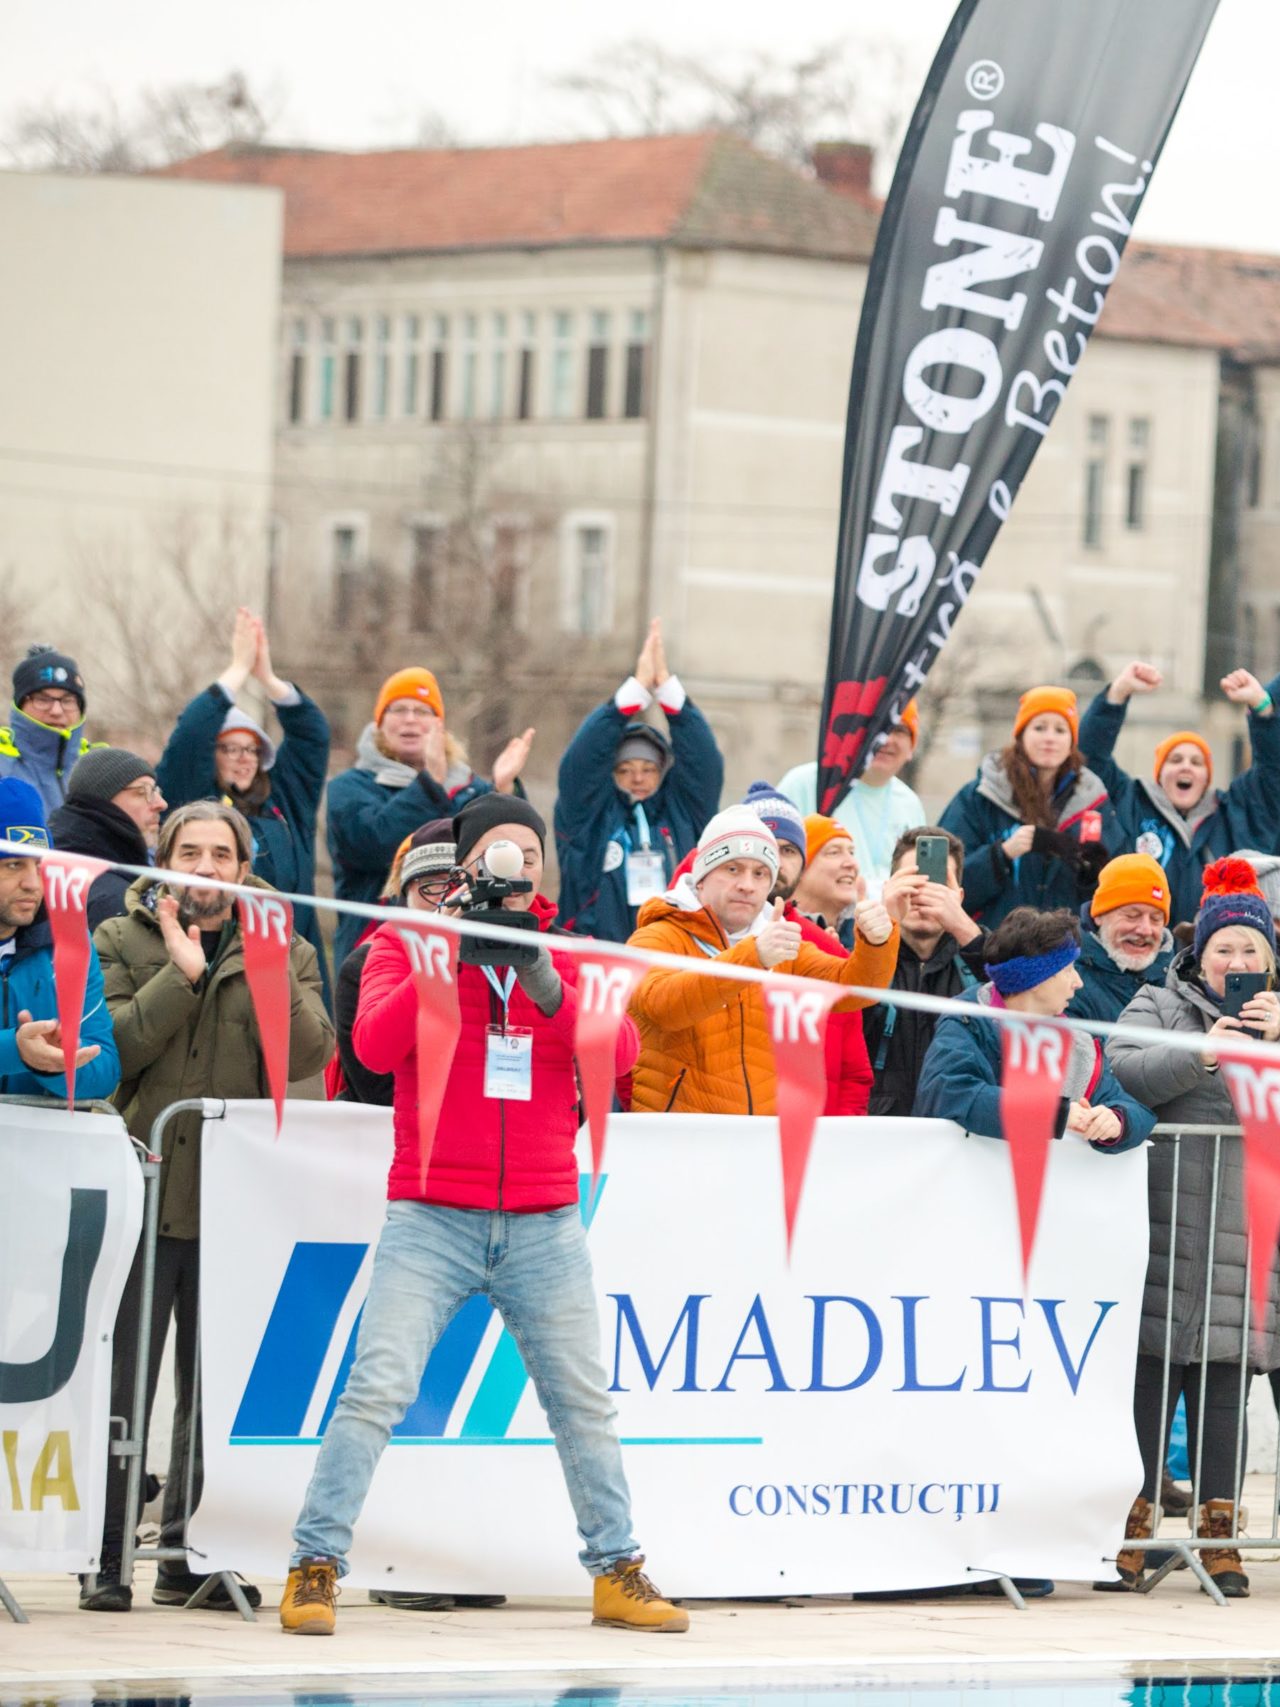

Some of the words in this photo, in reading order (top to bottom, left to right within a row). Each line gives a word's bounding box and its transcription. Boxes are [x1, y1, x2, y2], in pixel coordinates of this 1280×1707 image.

[1005, 136, 1153, 437] Beton!
[45, 866, 88, 912] TYR
[241, 893, 287, 945] TYR
[400, 929, 452, 984] TYR
[579, 962, 633, 1015] TYR
[768, 991, 824, 1043] TYR
[1004, 1020, 1063, 1081] TYR
[606, 1293, 1119, 1396] MADLEV
